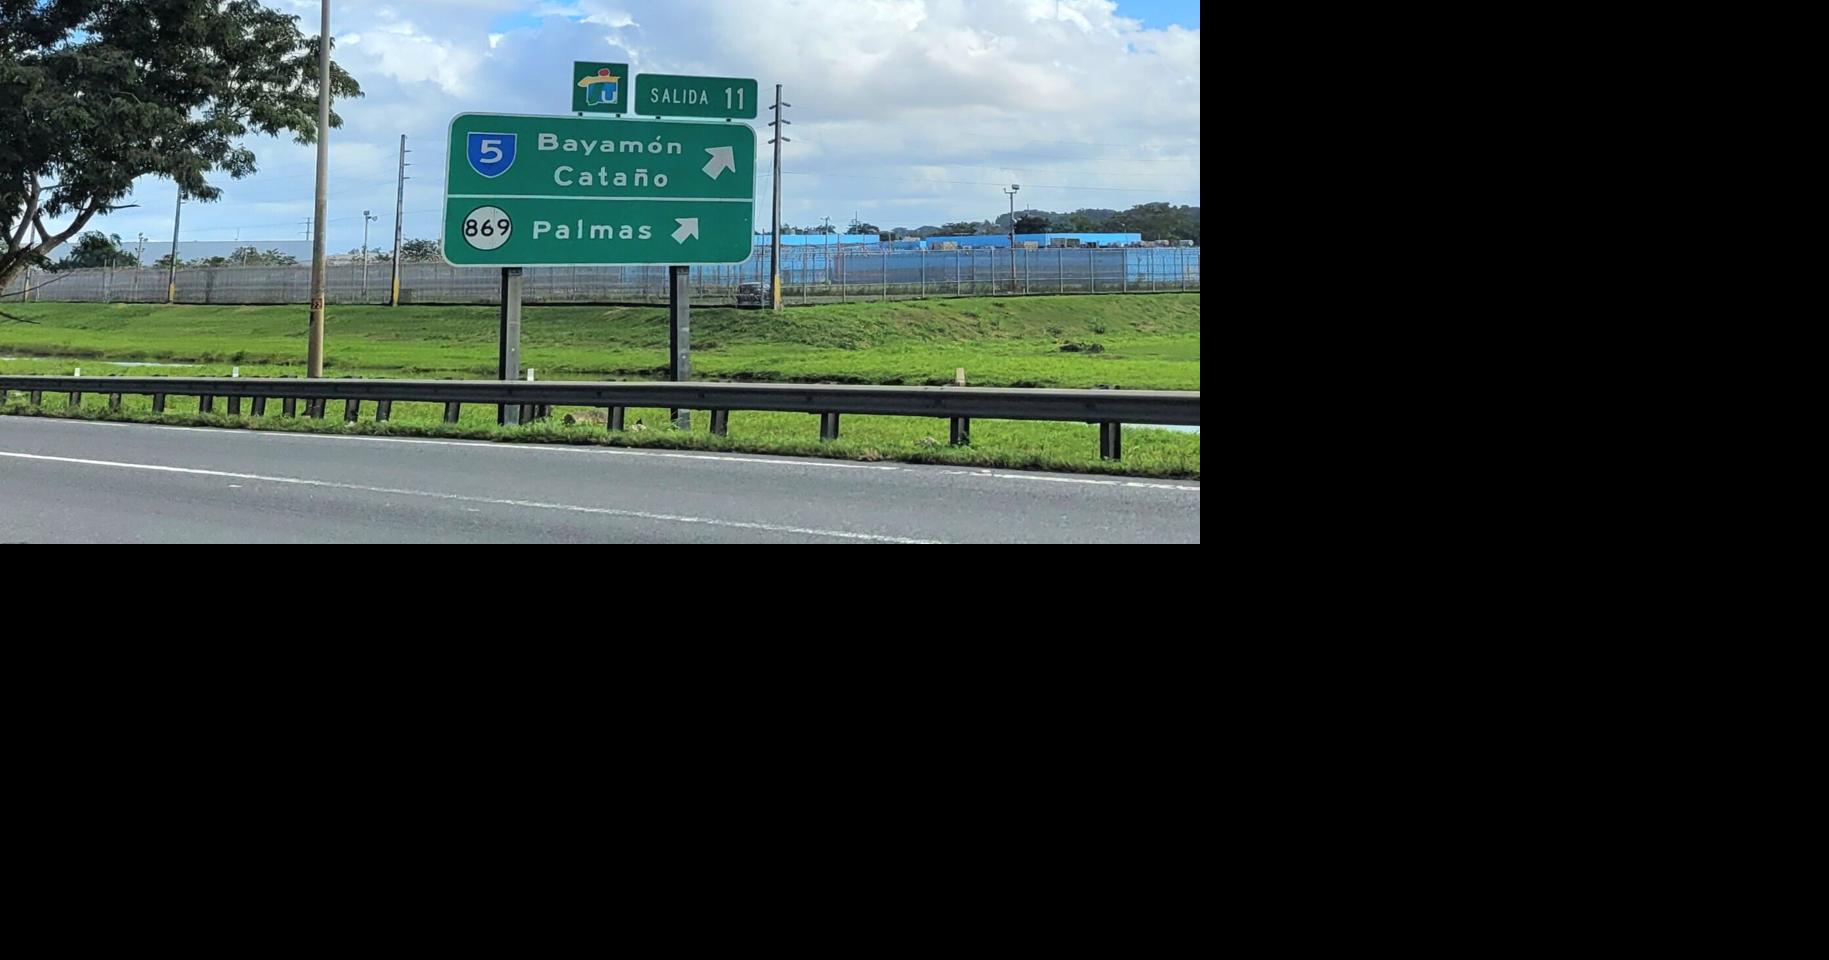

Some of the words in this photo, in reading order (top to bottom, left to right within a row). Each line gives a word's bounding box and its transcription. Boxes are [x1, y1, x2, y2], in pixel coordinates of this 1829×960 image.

[650, 87, 709, 105] SALIDA
[725, 87, 745, 110] 11
[479, 139, 504, 163] 5
[537, 133, 682, 156] Bayamón
[554, 165, 668, 187] Cataño
[465, 218, 511, 238] 869
[532, 219, 652, 240] Palmas
